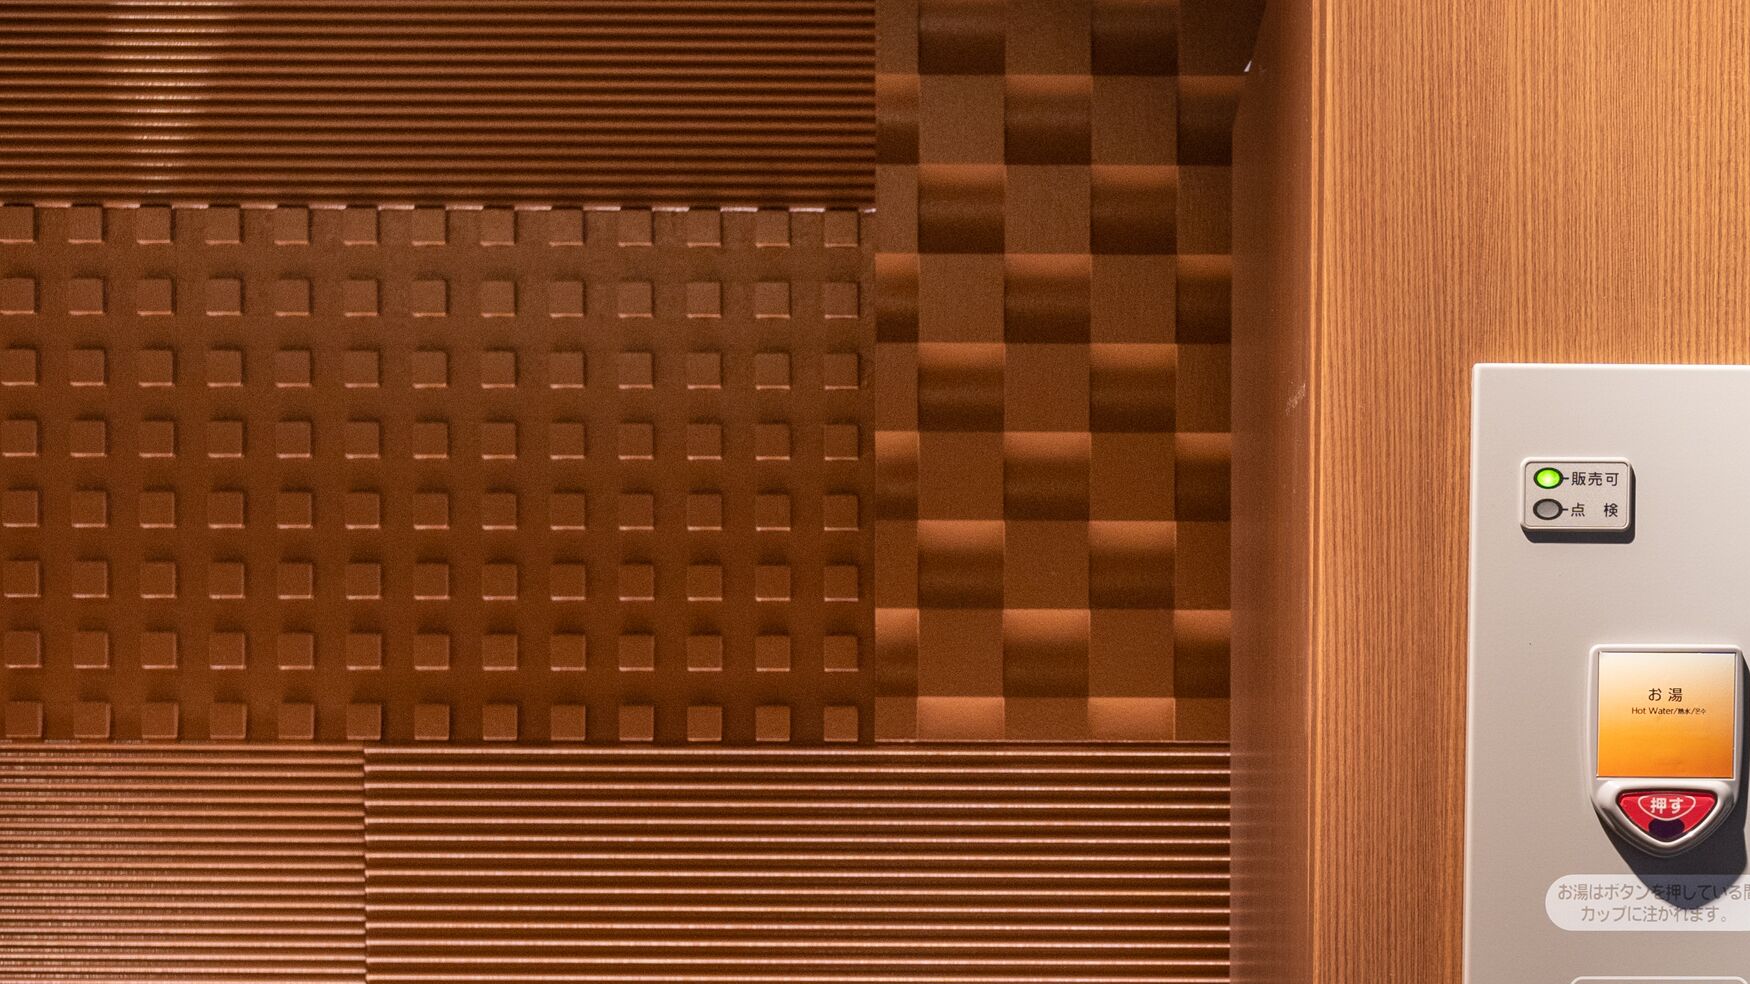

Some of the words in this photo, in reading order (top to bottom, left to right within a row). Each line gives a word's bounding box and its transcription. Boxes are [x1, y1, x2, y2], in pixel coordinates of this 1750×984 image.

[1571, 471, 1619, 486] 販売可
[1631, 707, 1646, 715] Hot
[1650, 798, 1683, 814] 押す
